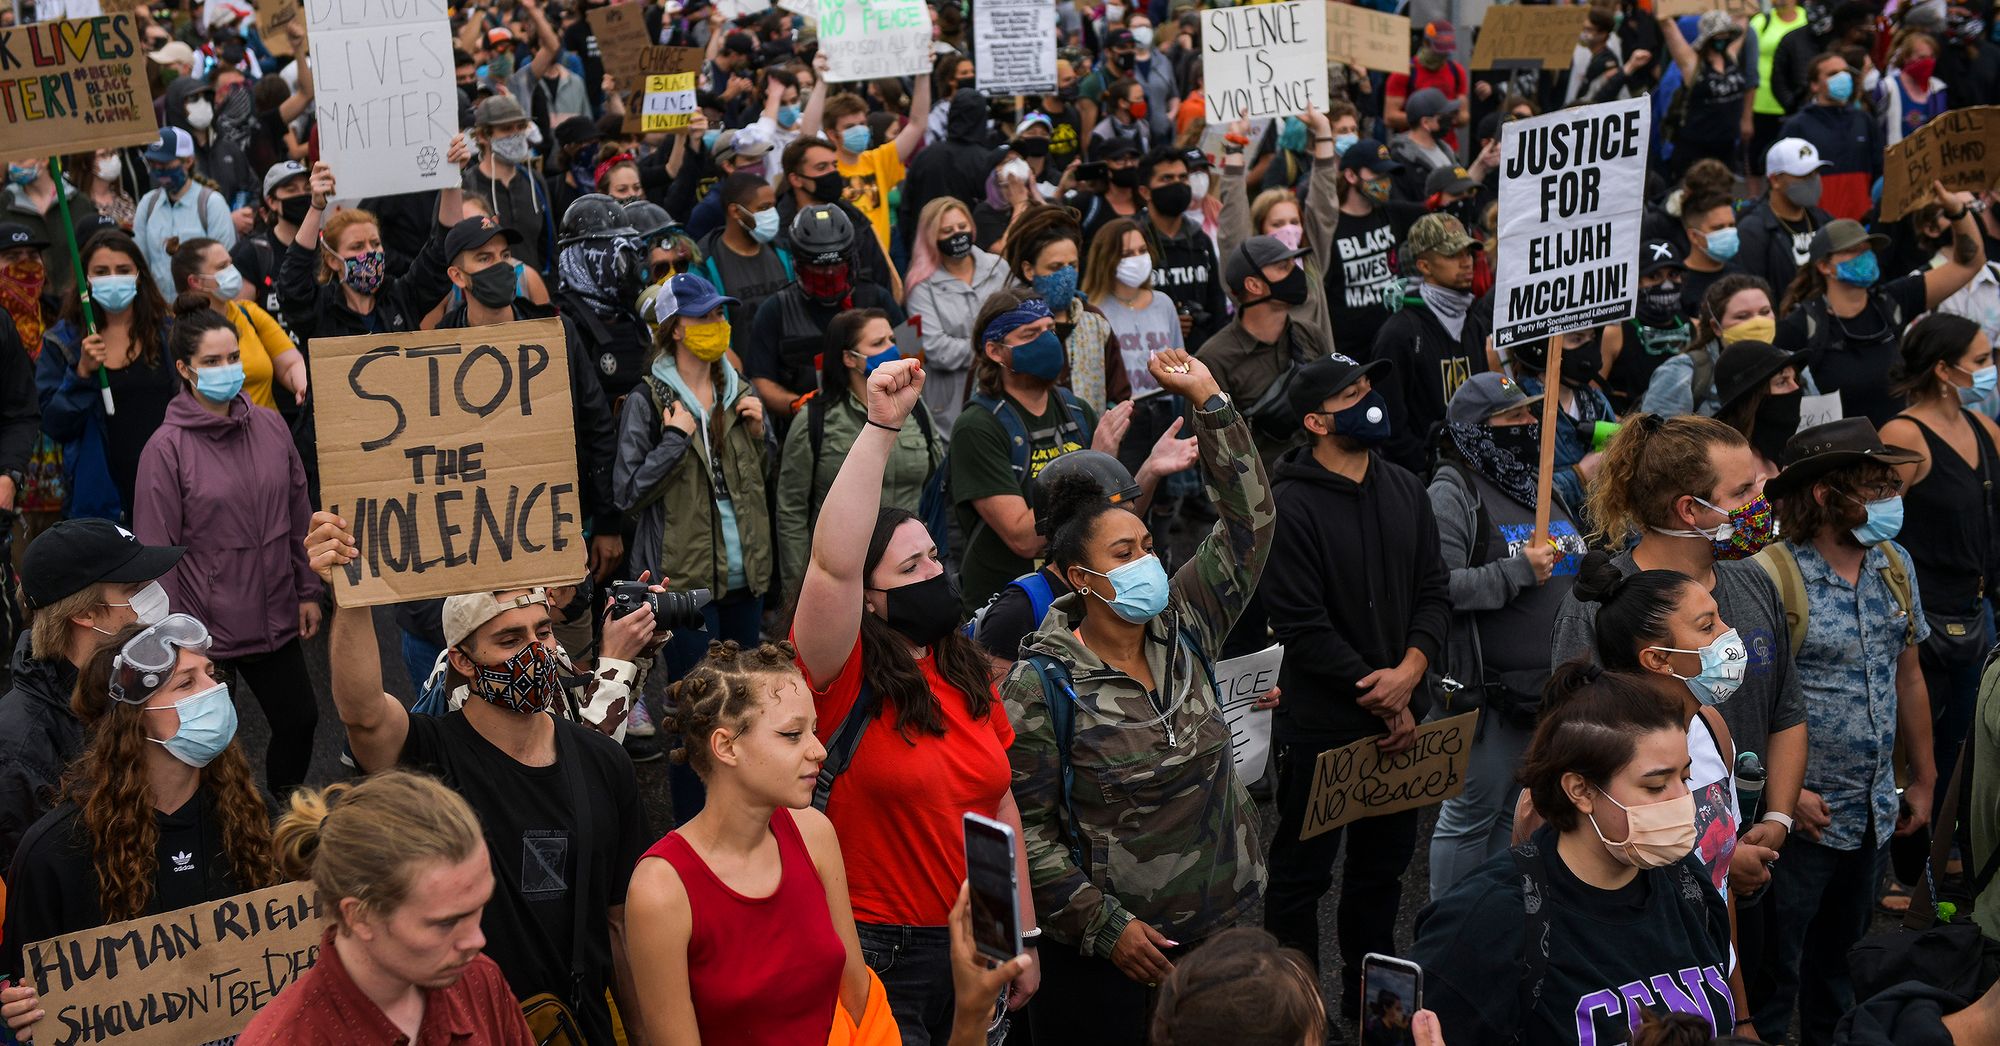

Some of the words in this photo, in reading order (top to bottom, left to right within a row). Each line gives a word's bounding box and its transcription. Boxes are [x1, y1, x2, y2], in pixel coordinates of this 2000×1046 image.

[820, 9, 846, 38] NO
[862, 6, 921, 35] PEACE
[1209, 3, 1308, 53] SILENCE
[315, 31, 445, 92] LIVES
[1245, 49, 1274, 85] IS
[106, 90, 134, 107] NOT
[1207, 78, 1320, 121] VIOLENCE
[318, 91, 453, 151] MATTER
[1933, 111, 1983, 139] WILL
[1506, 110, 1641, 180] JUSTICE
[1540, 166, 1601, 223] FOR
[1337, 225, 1396, 260] BLACK
[1528, 222, 1612, 275] ELIJAH
[1345, 256, 1388, 284] LIVES
[1507, 262, 1629, 322] MCCLAIN!
[1517, 320, 1537, 334] Party
[1536, 319, 1547, 330] for
[1546, 313, 1579, 327] Socialism
[1579, 309, 1592, 320] and
[1592, 303, 1625, 317] Liberation
[348, 343, 549, 452] STOP
[404, 442, 487, 485] THE
[331, 482, 573, 586] VIOLENCE
[173, 864, 195, 873] adidas
[27, 914, 202, 998] HUMAN
[218, 980, 270, 1017] BE
